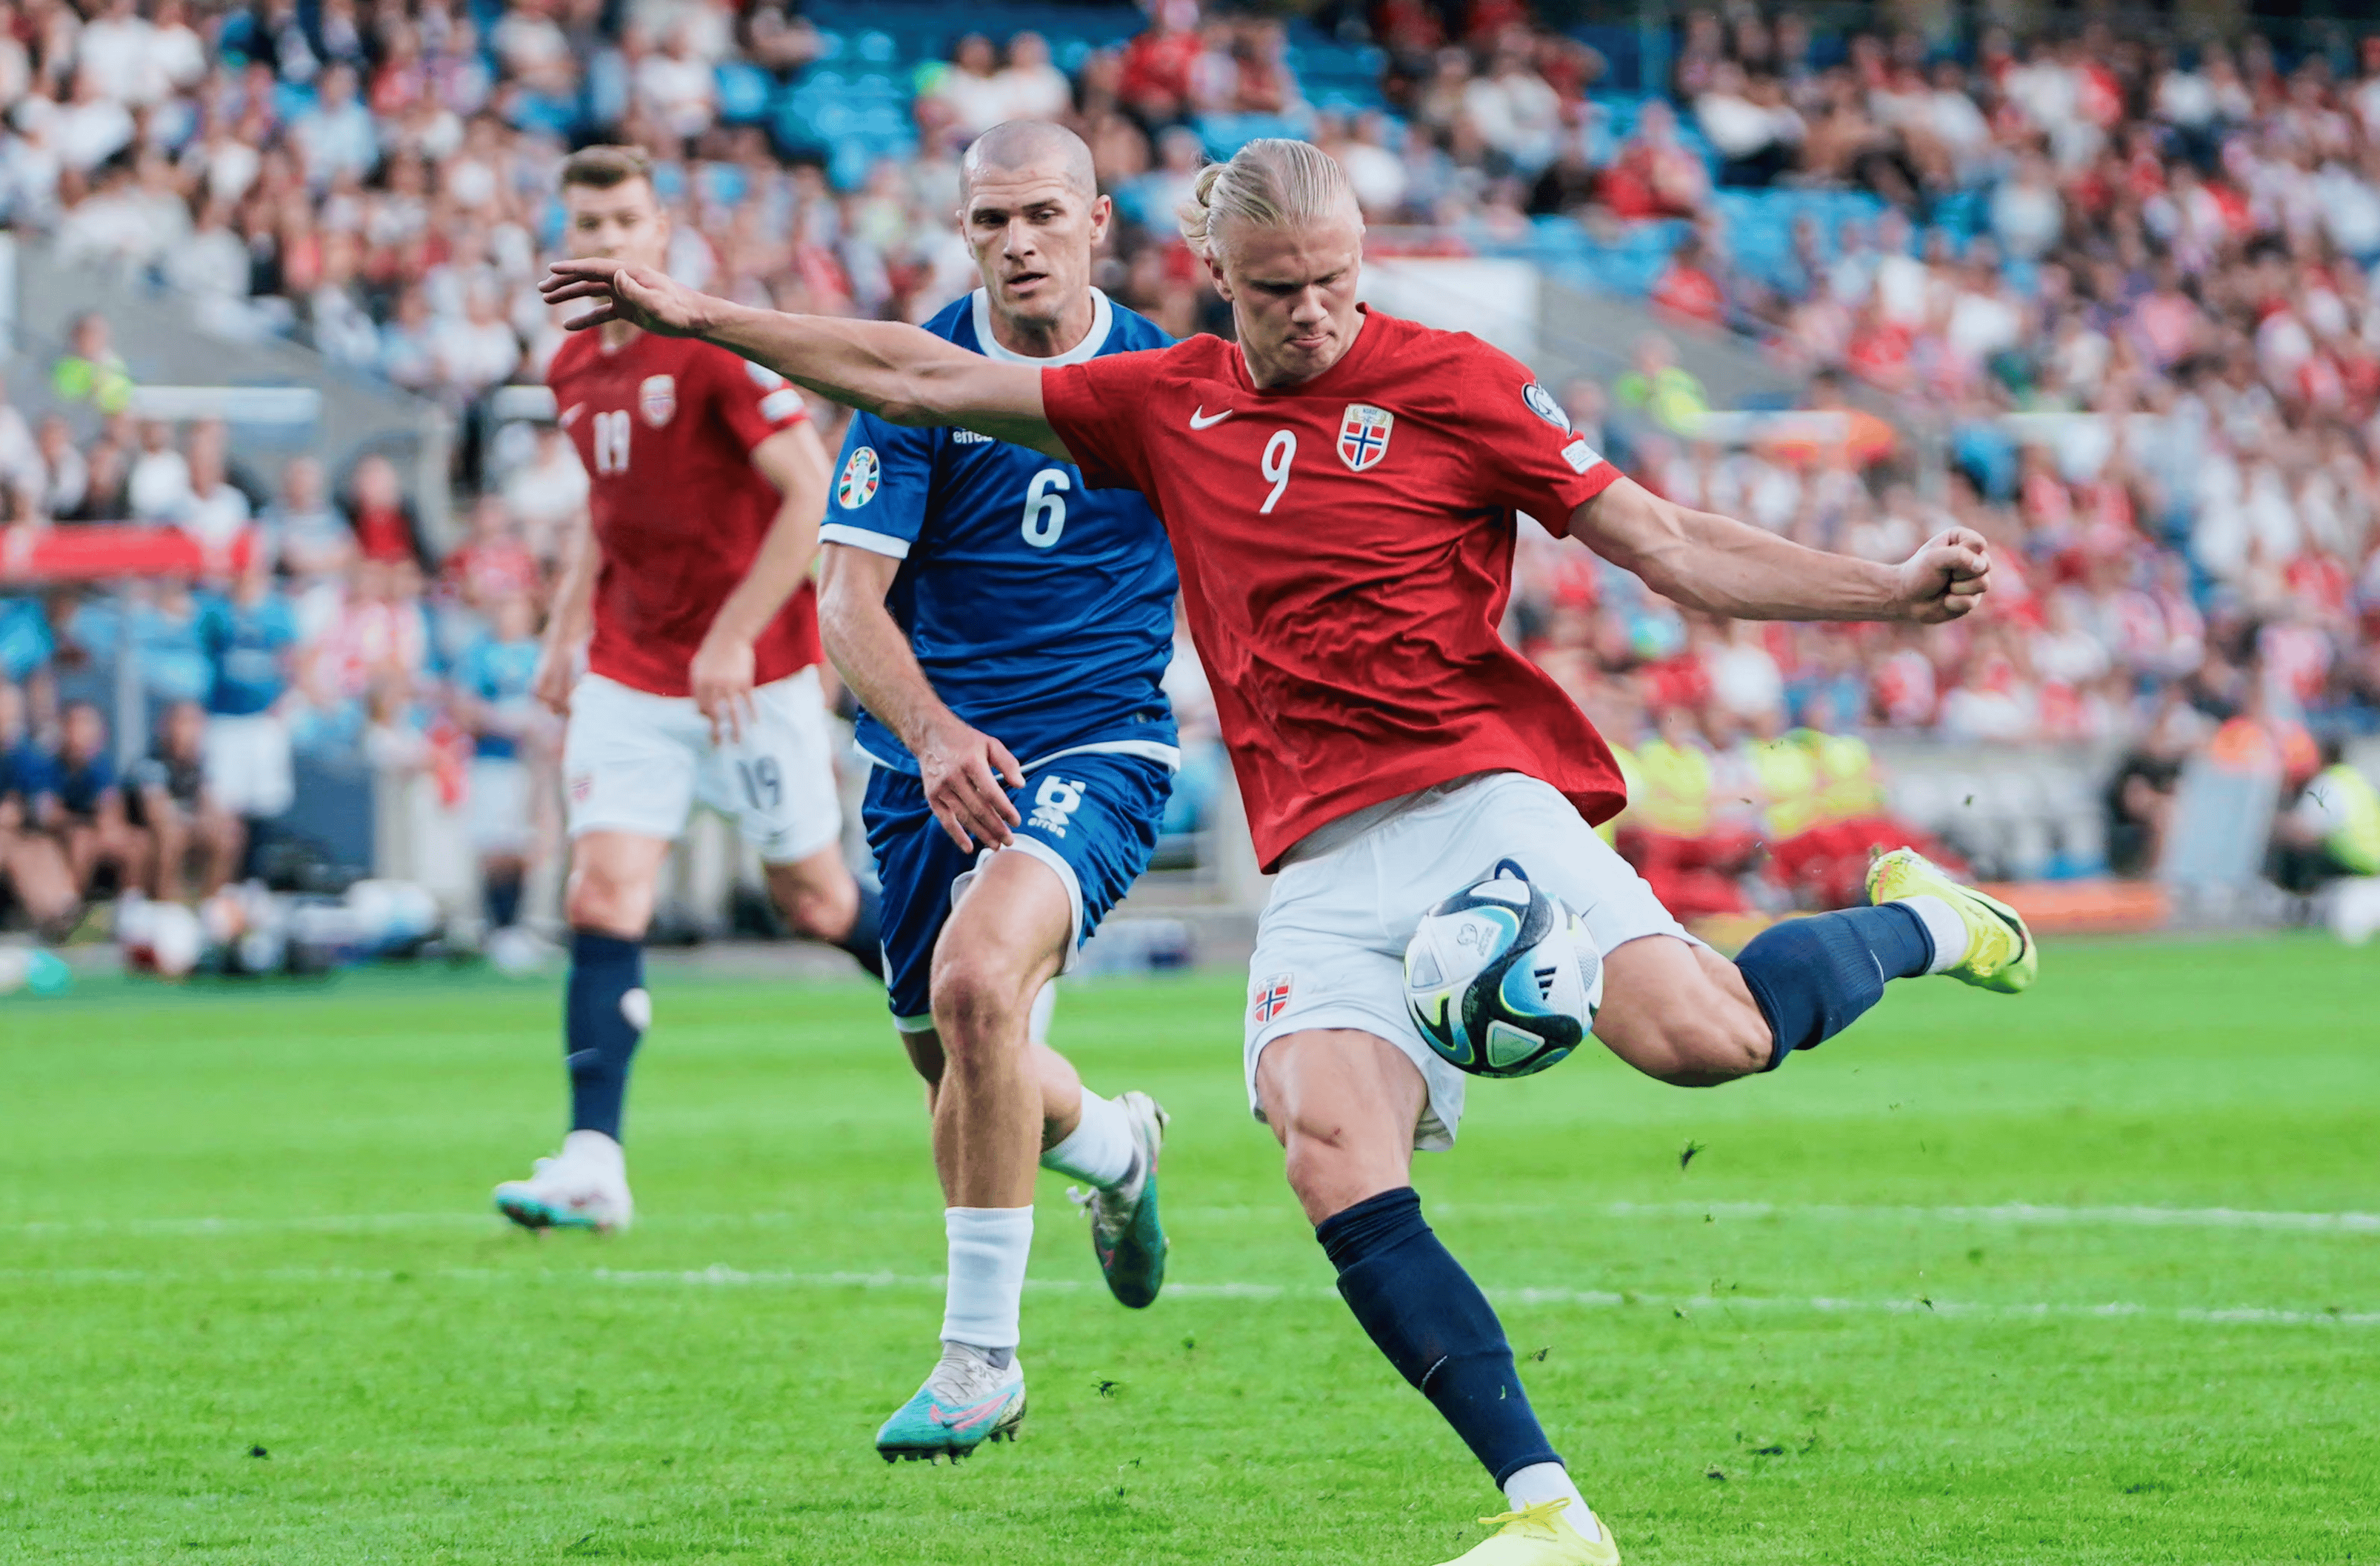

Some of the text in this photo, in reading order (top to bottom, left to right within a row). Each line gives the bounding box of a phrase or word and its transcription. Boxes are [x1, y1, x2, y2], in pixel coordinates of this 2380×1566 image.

[593, 409, 630, 475] 19
[1259, 429, 1297, 513] 9
[1021, 468, 1071, 547] 6
[736, 755, 783, 810] 19
[1035, 775, 1087, 814] 6
